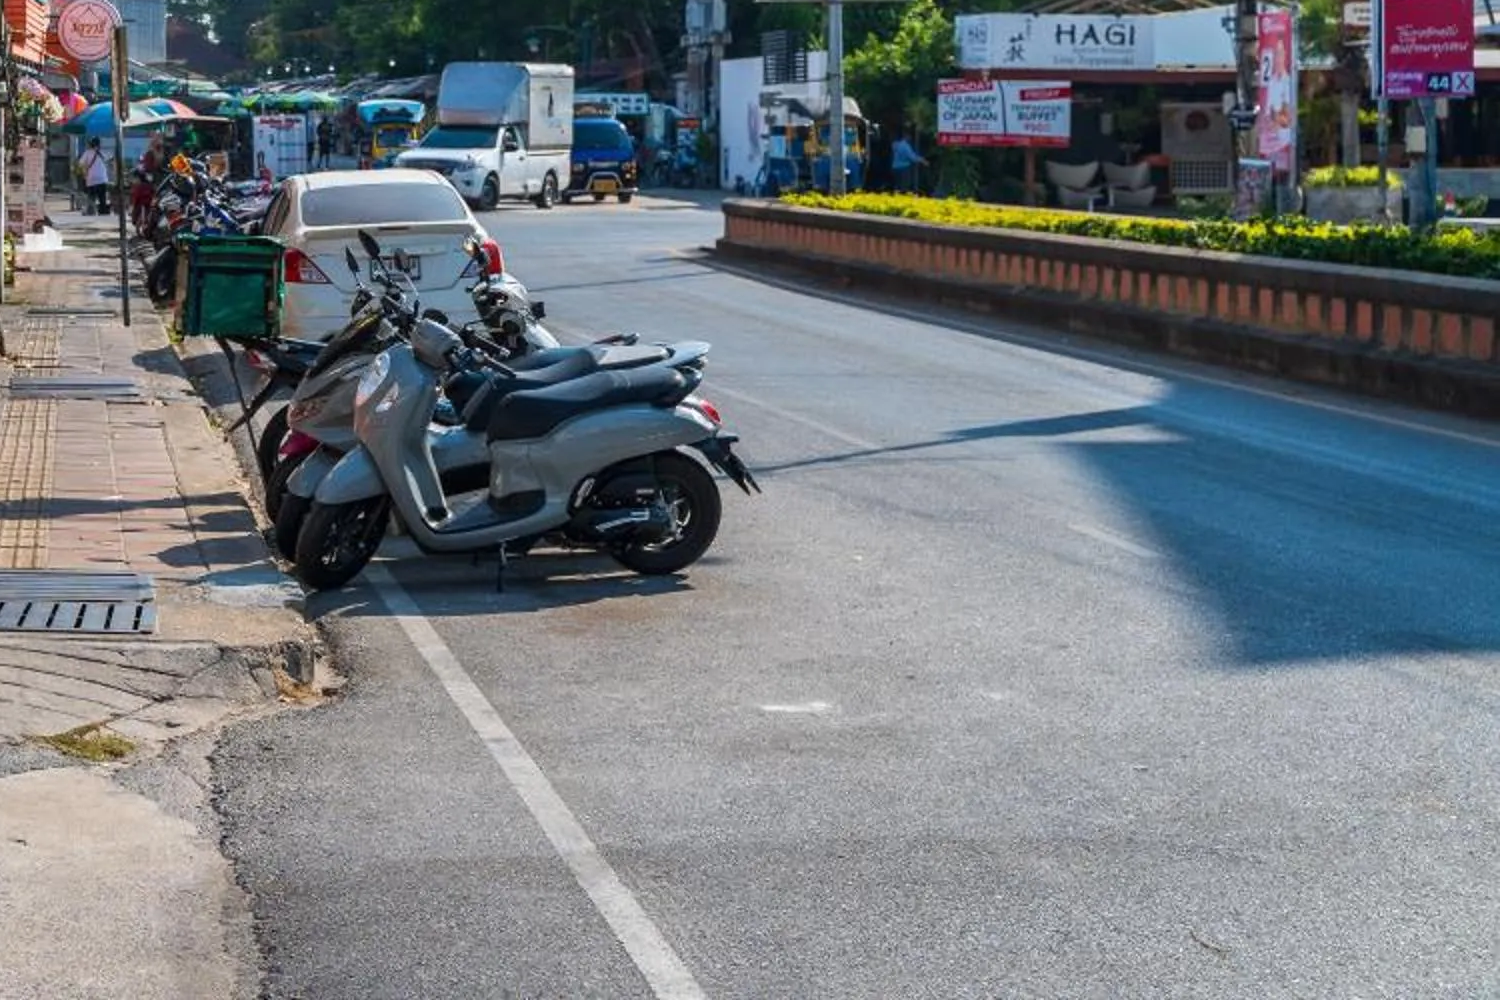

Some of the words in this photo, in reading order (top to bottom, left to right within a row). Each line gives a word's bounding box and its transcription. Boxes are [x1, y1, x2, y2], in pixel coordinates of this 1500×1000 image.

[1055, 23, 1135, 46] HAGI
[1263, 56, 1271, 81] 2
[1427, 75, 1450, 90] 44
